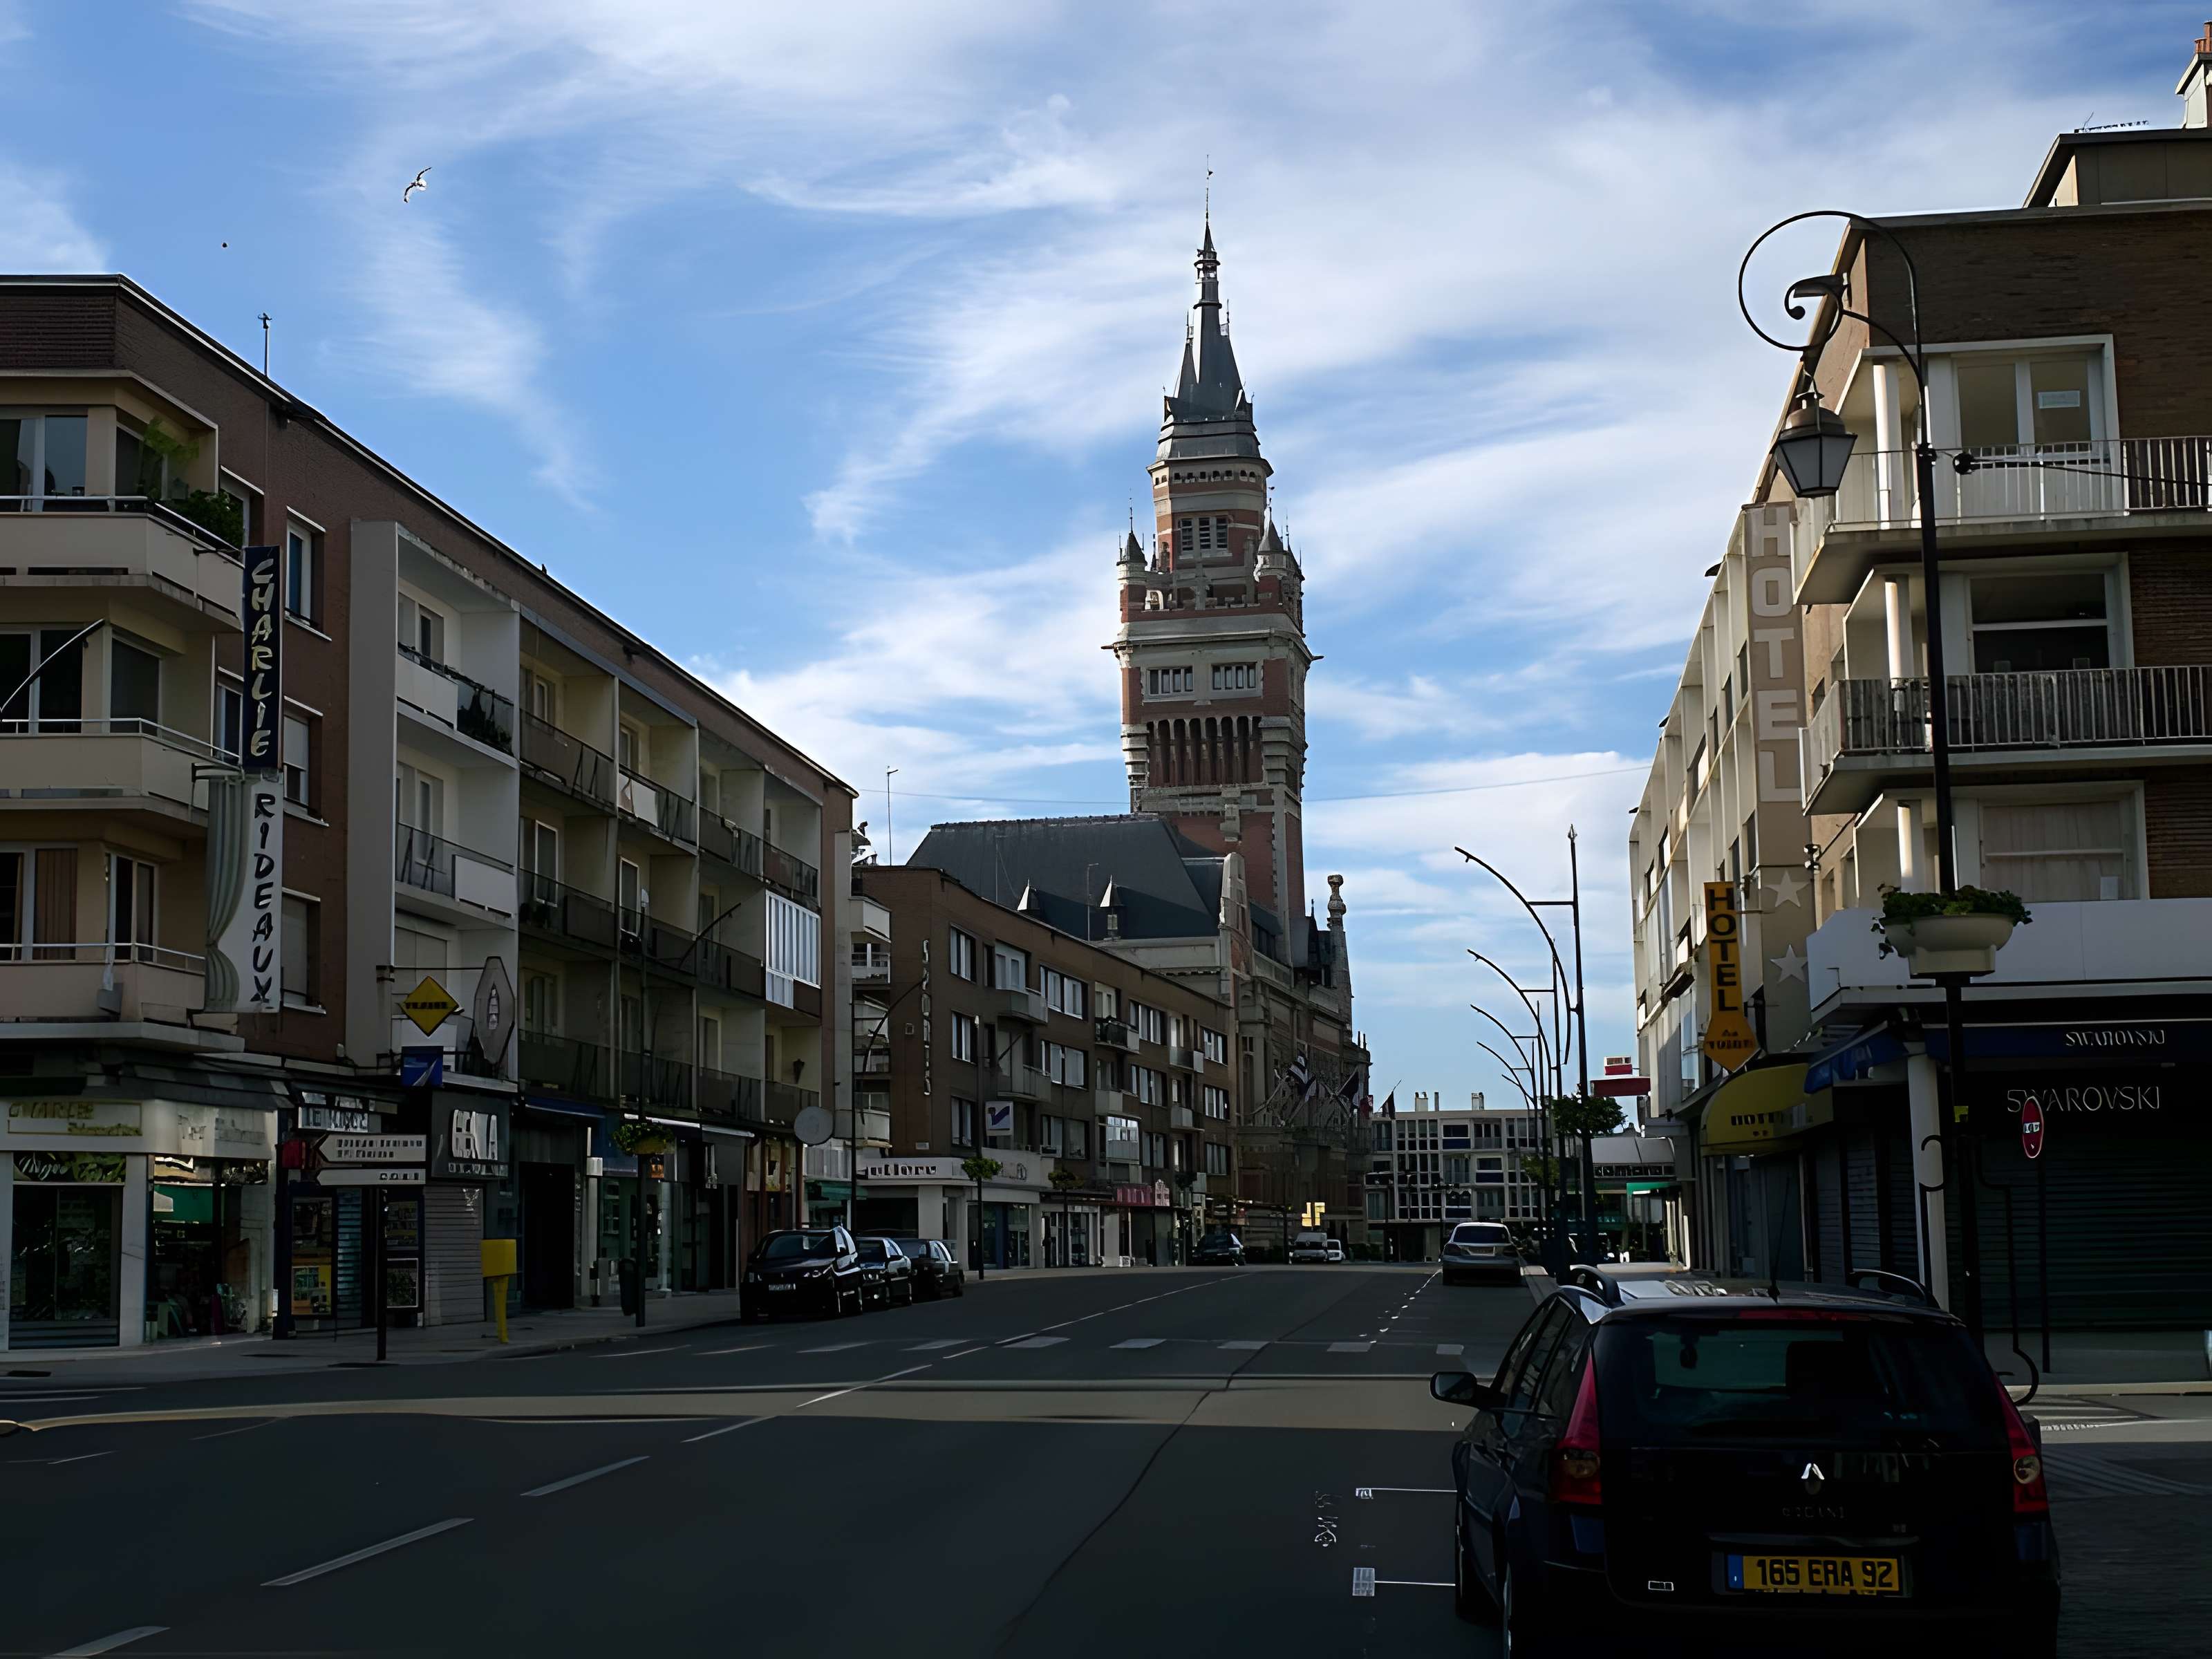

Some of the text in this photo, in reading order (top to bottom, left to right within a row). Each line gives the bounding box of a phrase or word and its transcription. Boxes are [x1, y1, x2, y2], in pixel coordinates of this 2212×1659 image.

[1747, 505, 1801, 802] HOTEL
[250, 558, 275, 1004] CHARLIE RIDEAUX
[1709, 888, 1738, 1011] HOTEL
[1756, 1559, 1893, 1587] 165 ERA 92
